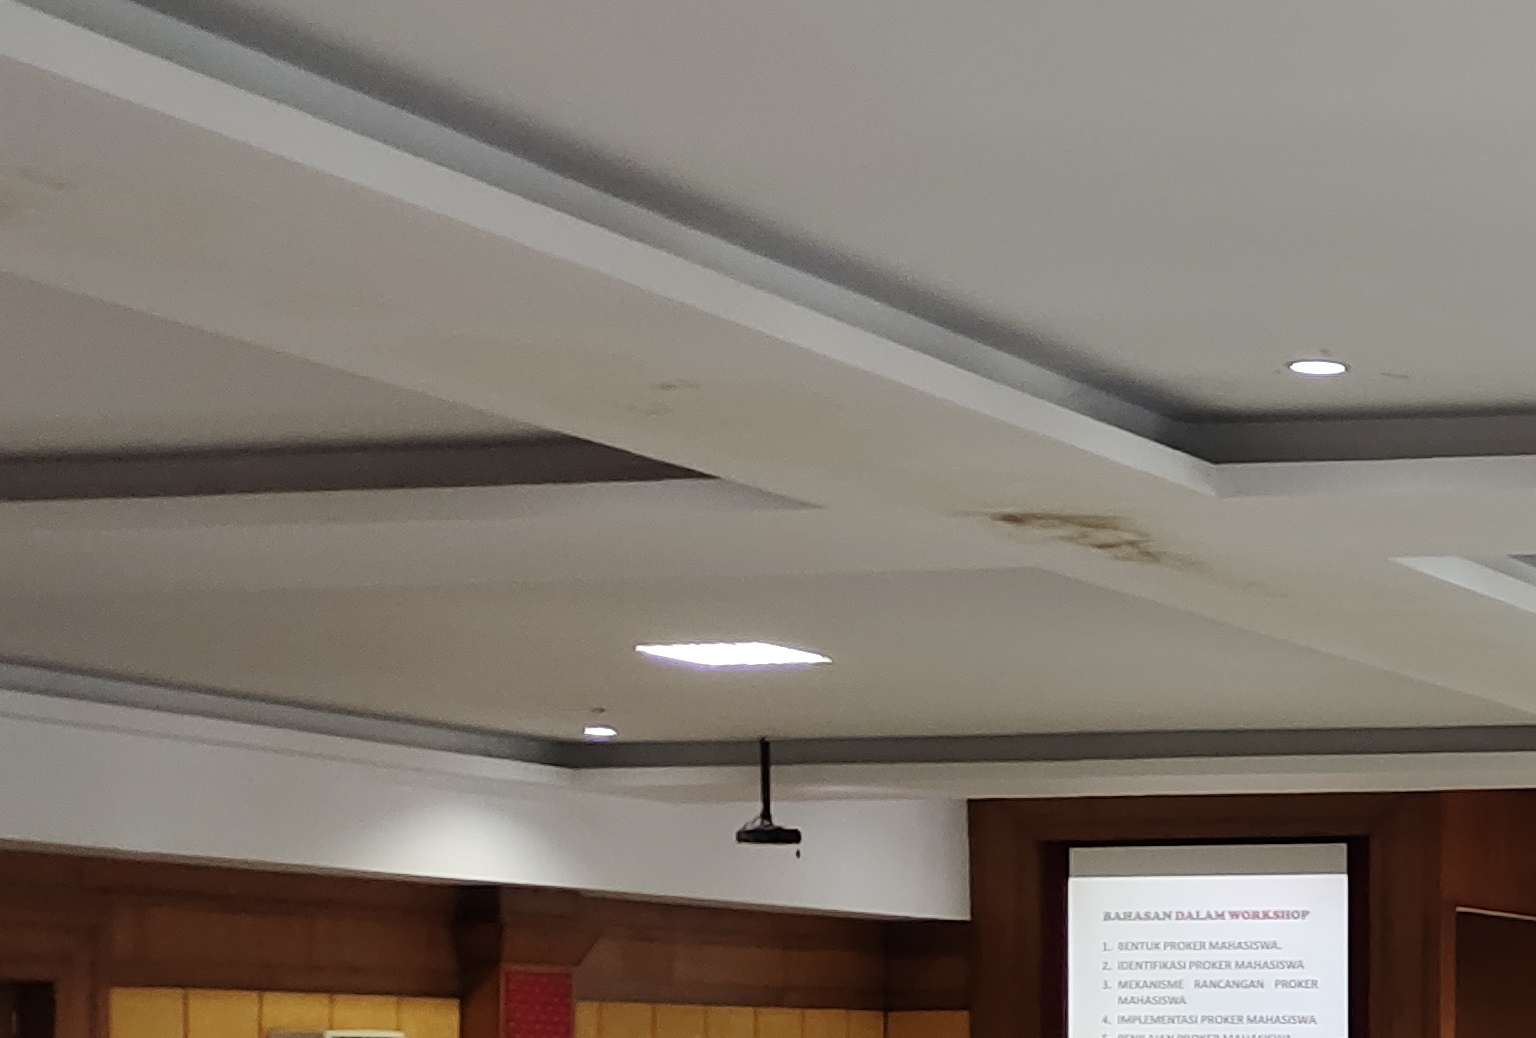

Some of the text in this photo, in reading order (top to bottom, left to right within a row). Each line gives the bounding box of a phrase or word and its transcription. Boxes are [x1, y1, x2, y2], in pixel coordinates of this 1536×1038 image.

[1103, 910, 1310, 920] BAHASAN DALAM WORKSHOP
[1118, 942, 1161, 951] BENTUK
[1164, 942, 1206, 951] PROKER
[1118, 961, 1186, 970] IDENTIFIKASI
[1189, 961, 1231, 970] PROKER
[1235, 961, 1304, 970] MAHASISWA
[1118, 980, 1183, 989] MEKANISME
[1194, 980, 1264, 989] RANCANGAN
[1275, 980, 1318, 989] PROKER
[1118, 996, 1186, 1005] MAHASISWA
[1118, 1015, 1197, 1024] IMPLEMENTASI
[1201, 1015, 1243, 1024] PROKER
[1246, 1015, 1317, 1024] MAHASISWA
